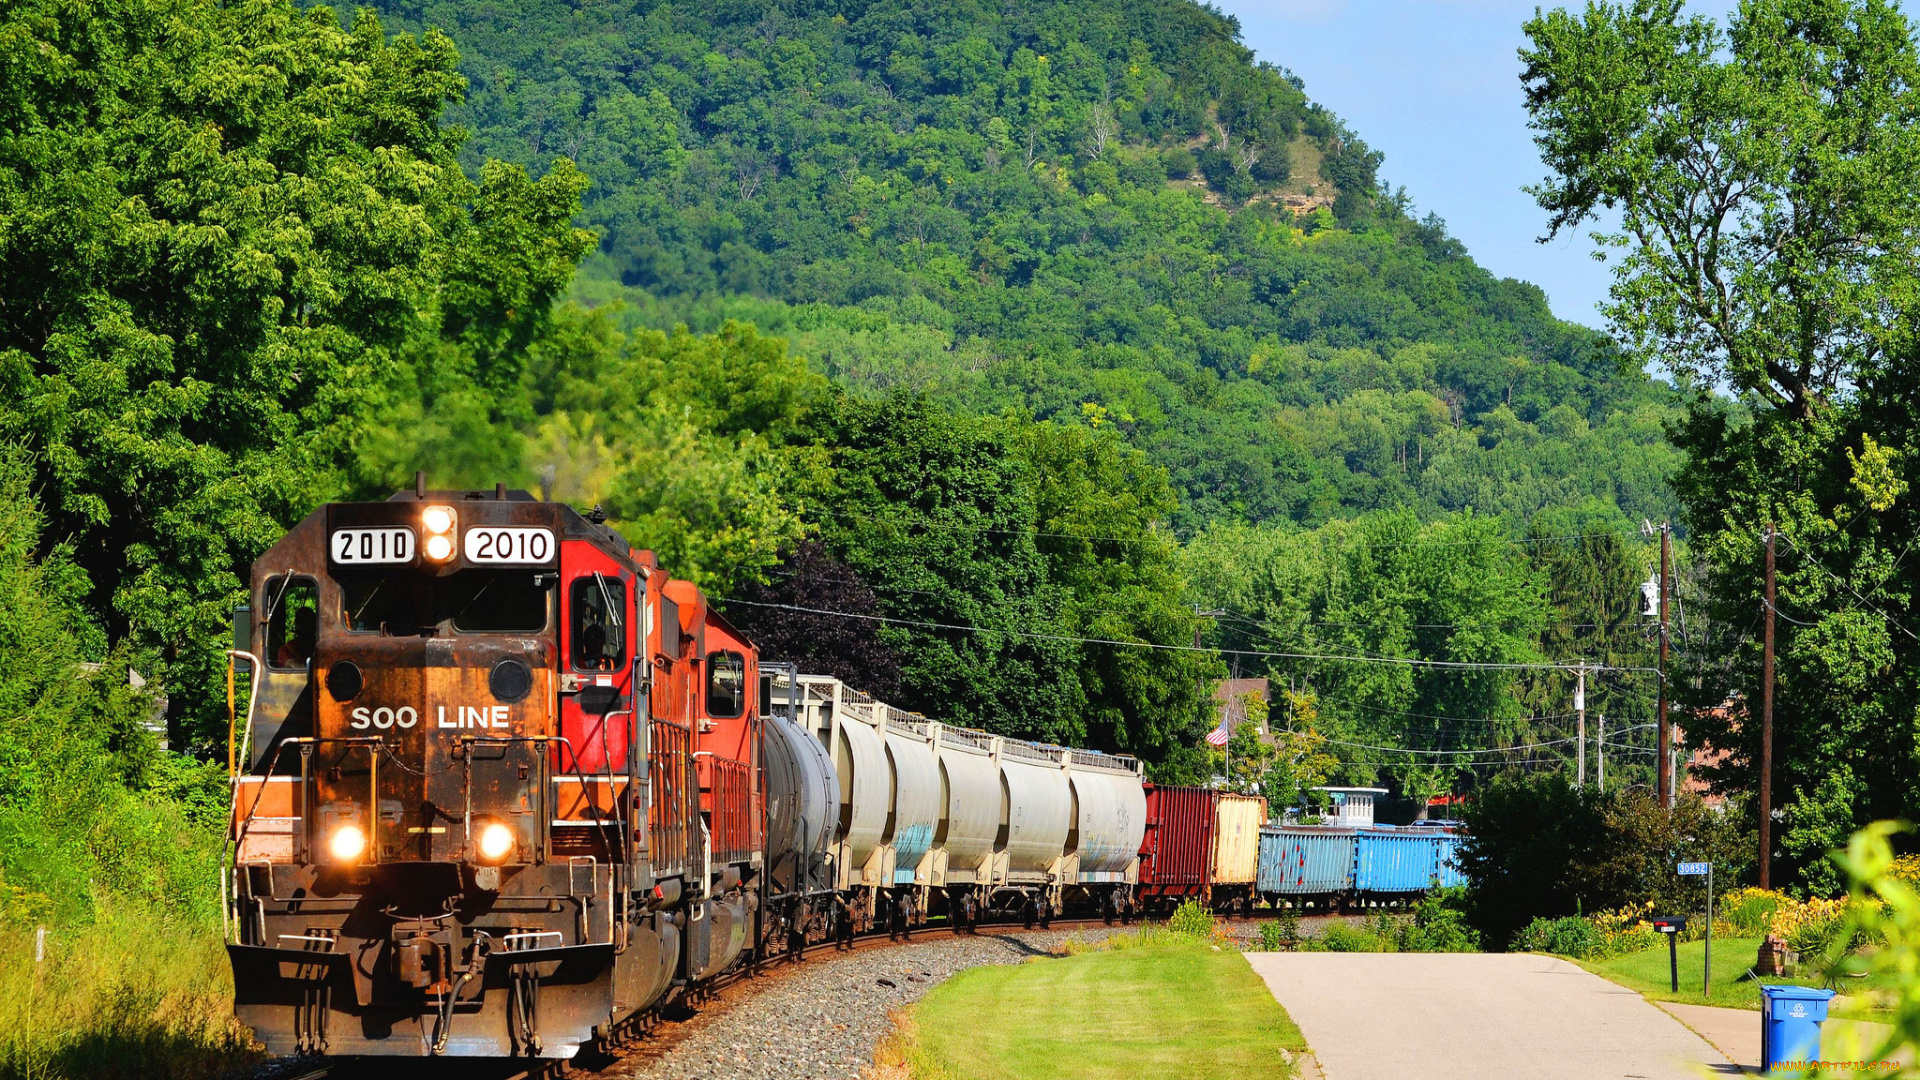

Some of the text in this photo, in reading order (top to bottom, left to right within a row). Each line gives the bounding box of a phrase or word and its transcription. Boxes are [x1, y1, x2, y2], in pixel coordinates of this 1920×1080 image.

[340, 532, 406, 560] 2010
[476, 531, 547, 560] 2010
[351, 706, 509, 729] SOO LINE
[1679, 864, 1706, 873] 30852
